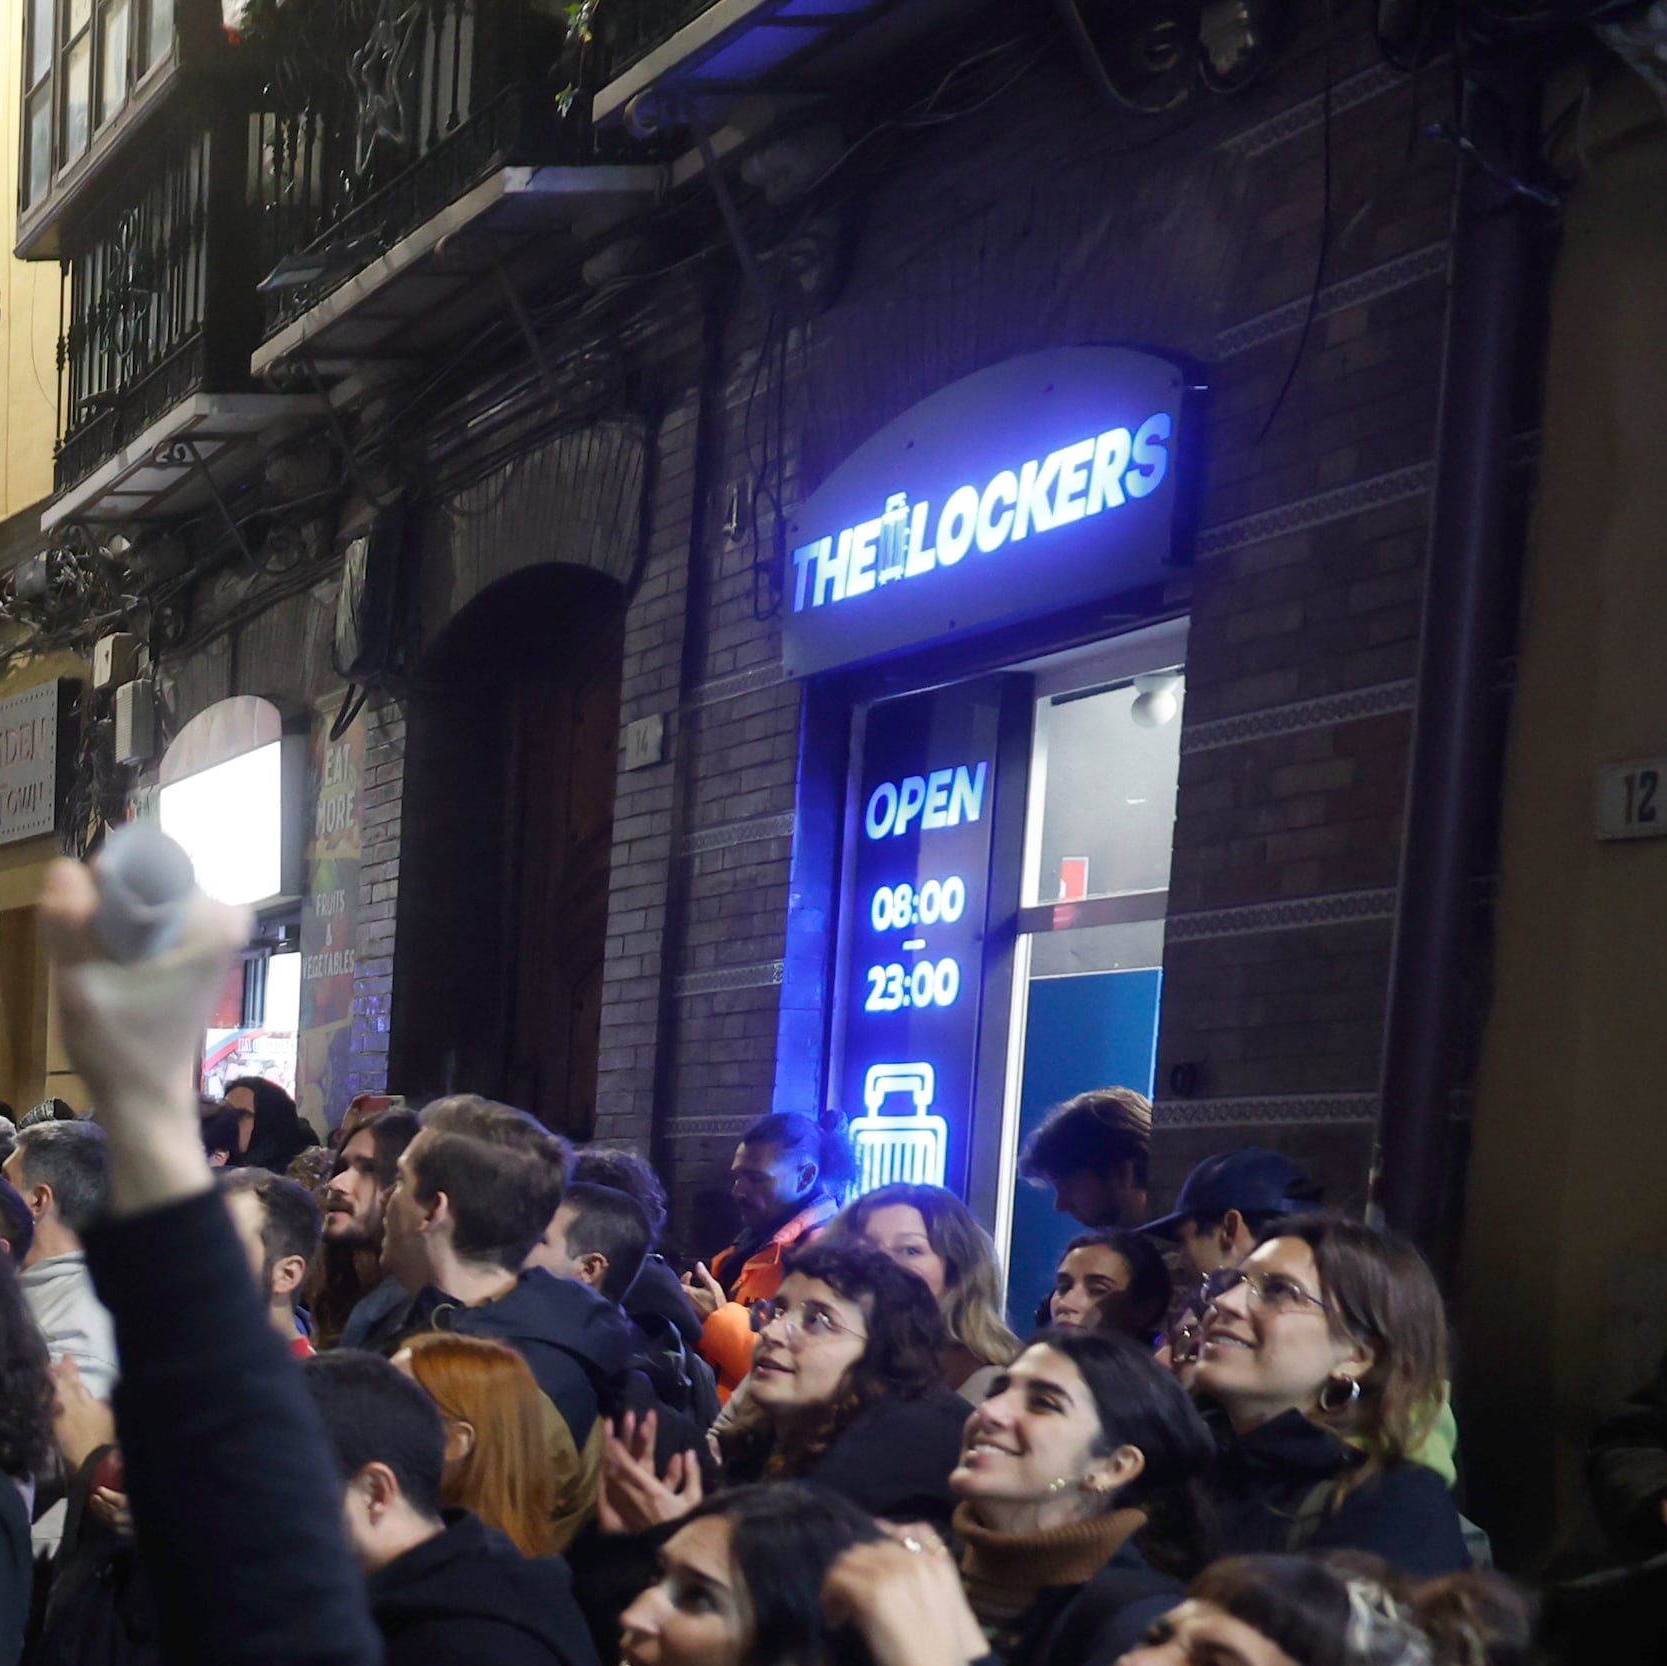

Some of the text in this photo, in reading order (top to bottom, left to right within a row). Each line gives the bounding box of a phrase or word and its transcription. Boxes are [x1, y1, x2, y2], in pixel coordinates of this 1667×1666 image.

[792, 411, 1173, 616] THE LOCKERS
[324, 742, 352, 786] EAT
[315, 792, 356, 836] MORE
[866, 761, 988, 840] OPEN
[1624, 770, 1659, 825] 12
[315, 888, 346, 918] FRUITS
[870, 876, 966, 933] 08:00
[302, 948, 356, 980] VEGETABLES
[865, 957, 961, 1012] 23:00
